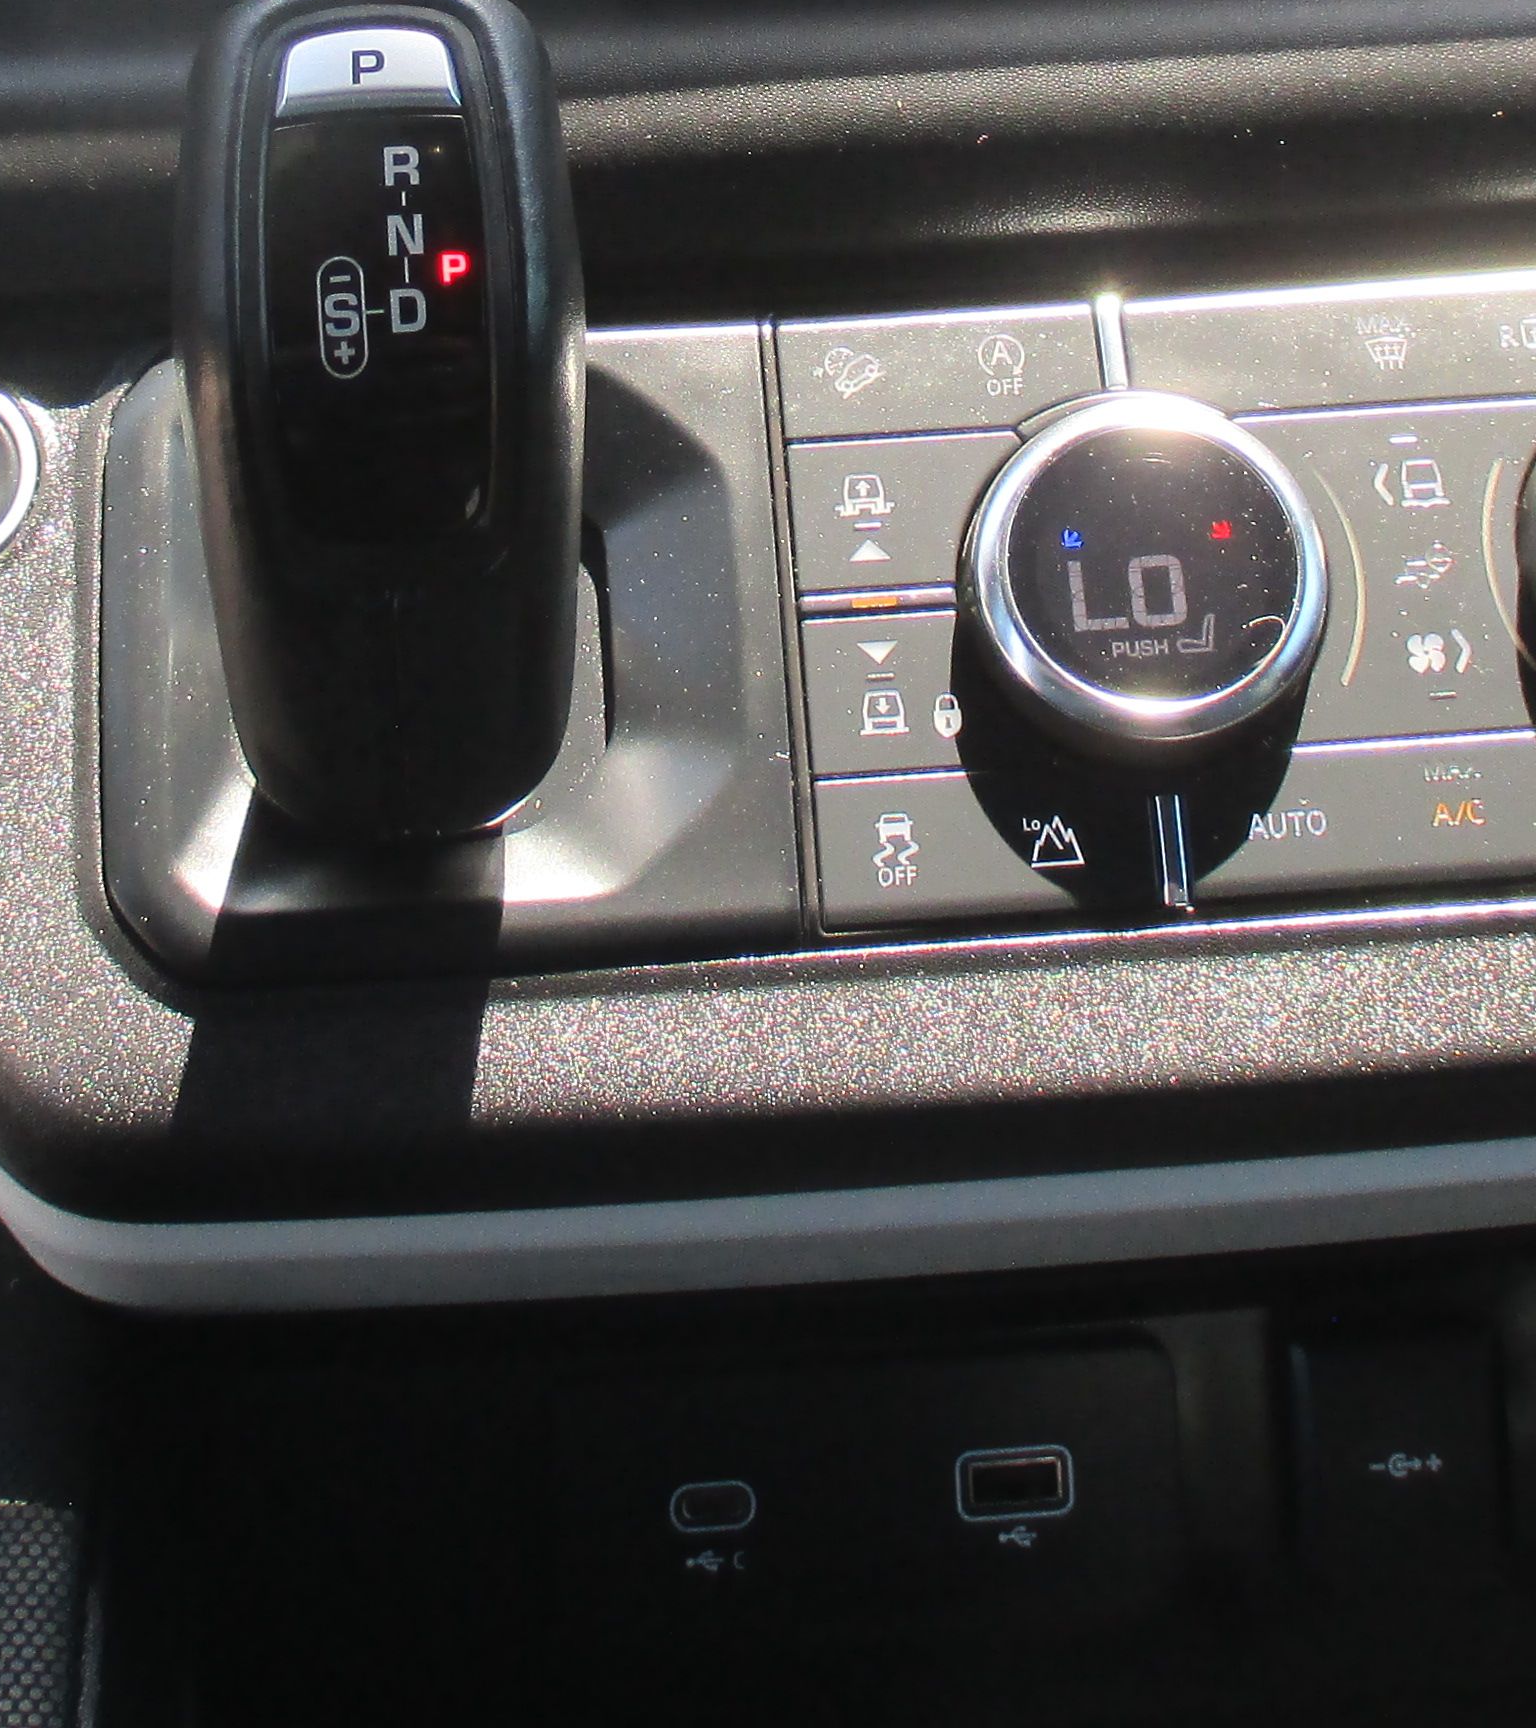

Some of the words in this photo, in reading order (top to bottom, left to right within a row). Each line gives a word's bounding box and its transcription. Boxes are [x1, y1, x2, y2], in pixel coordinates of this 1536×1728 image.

[351, 49, 386, 85] P
[382, 145, 421, 187] R
[387, 213, 425, 257] N
[439, 250, 469, 285] P
[323, 292, 361, 339] S
[389, 288, 427, 334] D
[986, 377, 1024, 397] OFF
[1066, 554, 1188, 633] LO
[1111, 638, 1170, 659] PUSH
[1248, 808, 1328, 841] AUTO
[1431, 798, 1486, 828] A/C
[877, 865, 918, 889] OFF
